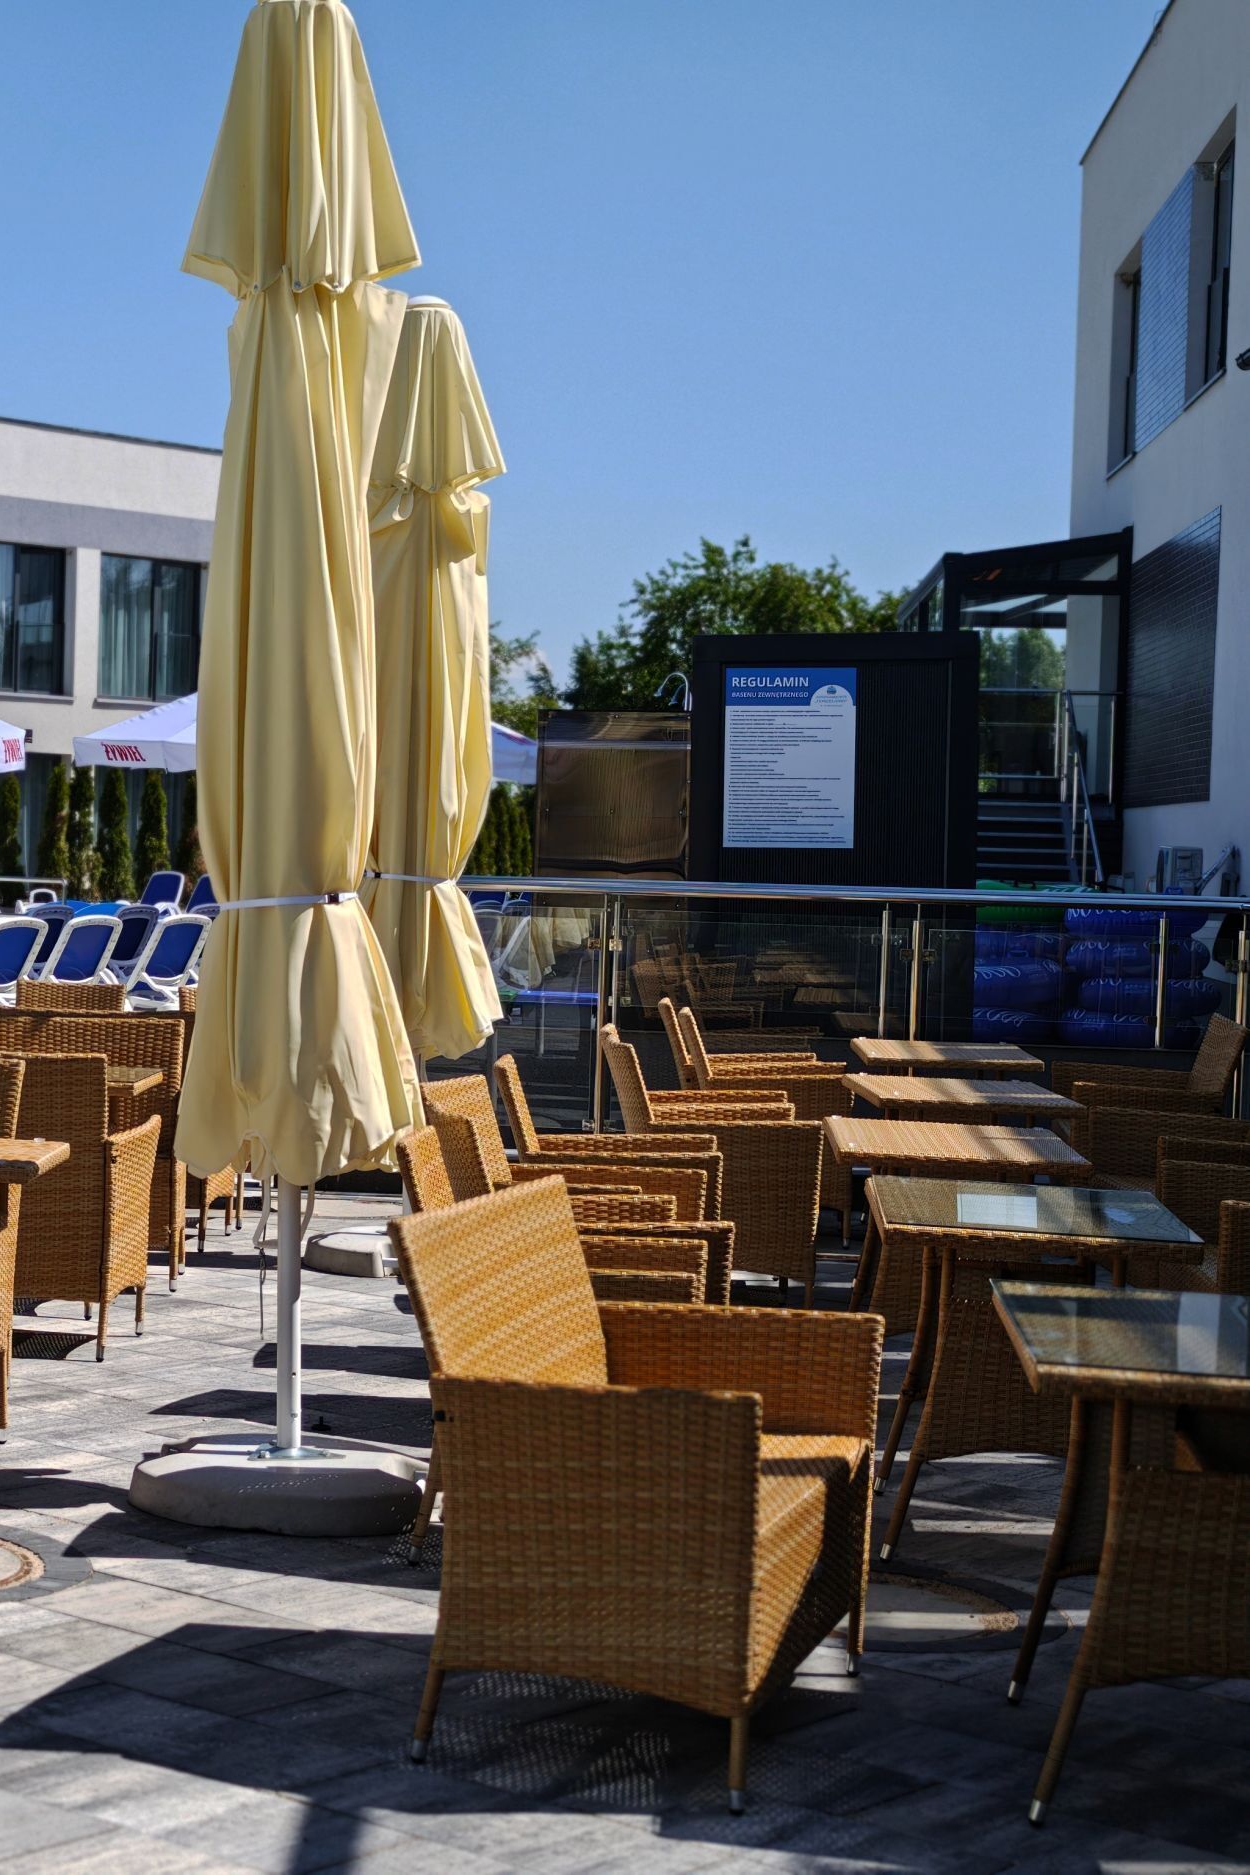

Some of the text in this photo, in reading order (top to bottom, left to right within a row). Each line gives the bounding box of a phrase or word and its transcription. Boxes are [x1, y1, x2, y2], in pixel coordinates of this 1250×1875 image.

[732, 677, 809, 687] REGULAMIN
[757, 691, 809, 699] ZEWNĘTRZNEGO
[100, 742, 147, 762] ŻYWIEC
